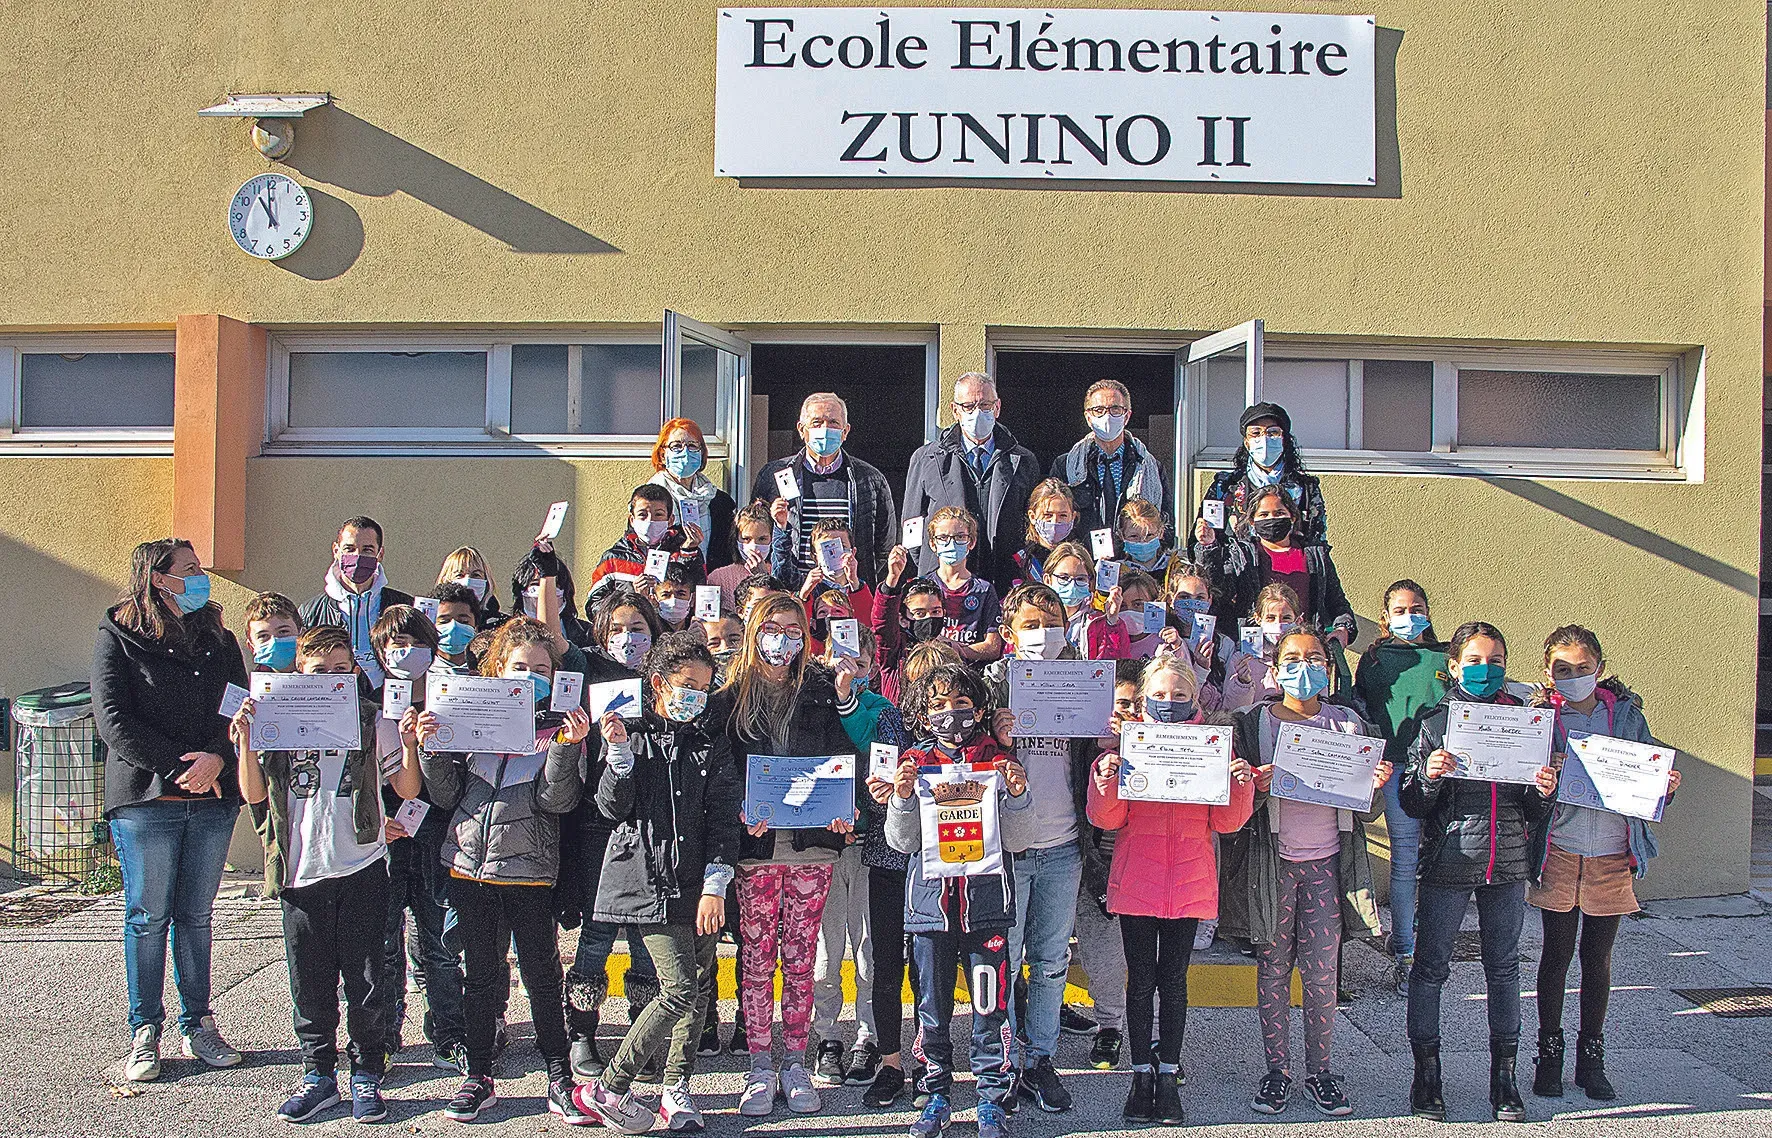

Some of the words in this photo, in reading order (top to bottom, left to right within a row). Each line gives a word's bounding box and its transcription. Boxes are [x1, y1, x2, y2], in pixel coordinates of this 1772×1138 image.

[745, 19, 927, 69] Ecole
[951, 20, 1347, 76] Elémentaire
[840, 111, 1171, 165] ZUNINO
[1197, 116, 1251, 167] II
[252, 184, 260, 194] 11
[286, 184, 290, 194] 1
[240, 196, 250, 206] 10
[295, 196, 303, 206] 2
[236, 212, 243, 222] 9
[300, 211, 306, 221] 3
[240, 228, 246, 238] 8
[293, 227, 301, 237] 4
[252, 240, 258, 249] 7
[284, 239, 290, 249] 5
[266, 245, 273, 254] 6
[940, 809, 979, 821] GARDE
